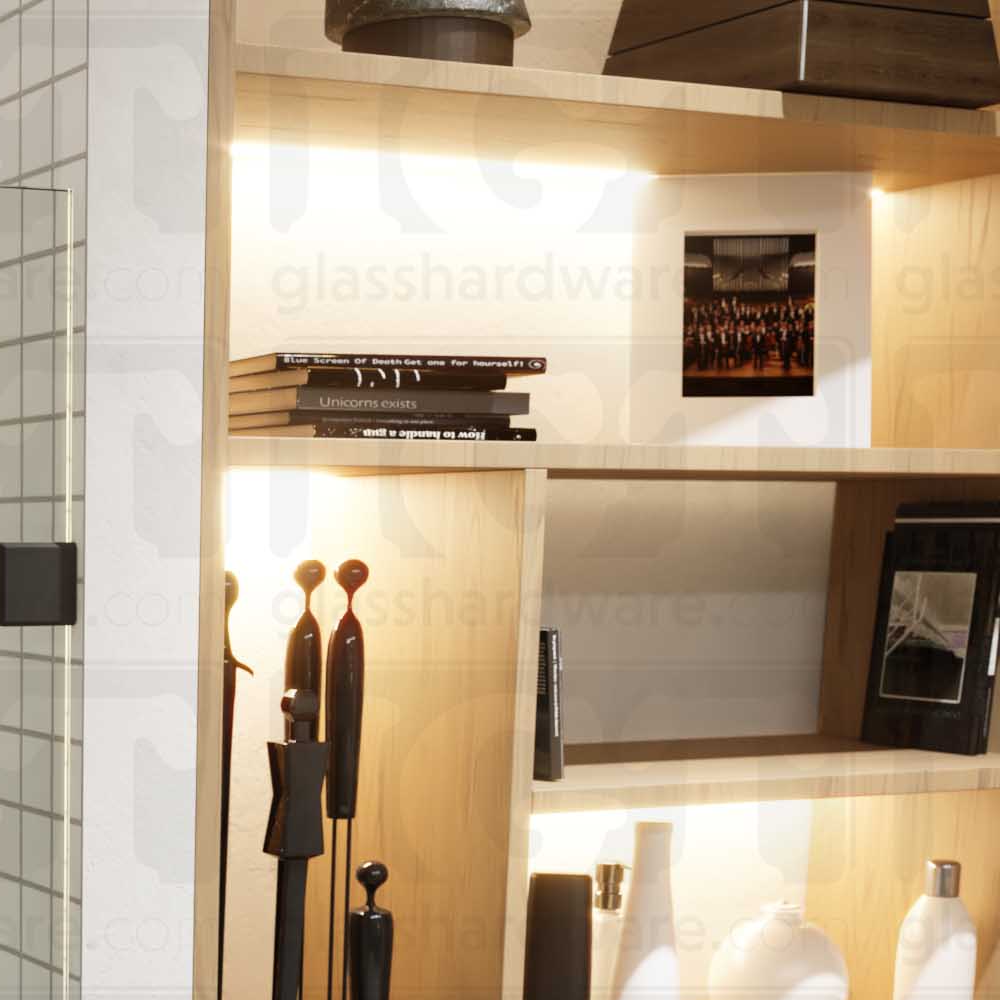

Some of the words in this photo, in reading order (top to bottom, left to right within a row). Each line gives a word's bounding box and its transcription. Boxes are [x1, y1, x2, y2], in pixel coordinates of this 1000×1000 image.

[283, 356, 309, 364] Blue
[313, 357, 350, 365] Screen
[404, 358, 422, 366] Get
[450, 359, 468, 367] for
[319, 396, 378, 409] Unicorns
[380, 398, 417, 410] exists
[389, 429, 397, 438] a
[398, 428, 441, 440] handle
[442, 429, 455, 440] to
[457, 429, 487, 440] How
